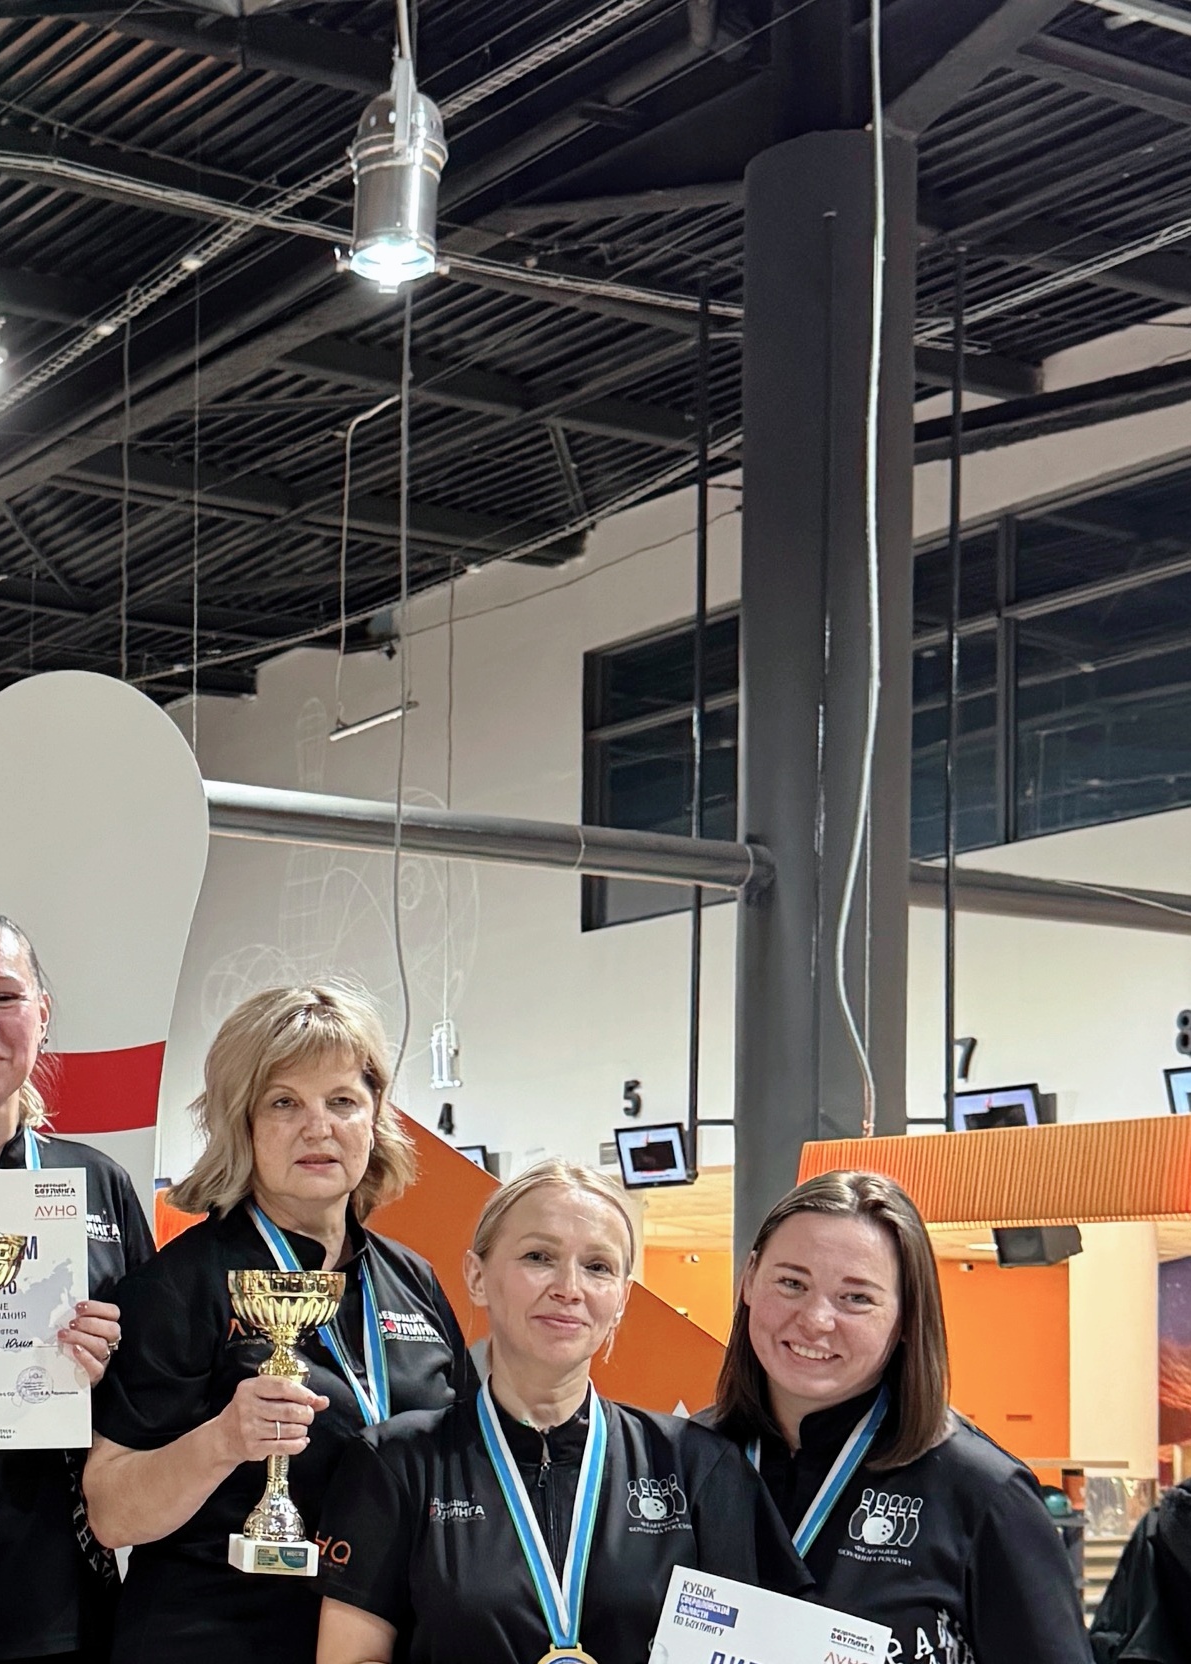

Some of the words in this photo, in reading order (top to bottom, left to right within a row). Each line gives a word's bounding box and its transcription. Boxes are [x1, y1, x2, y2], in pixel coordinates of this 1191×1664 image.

[953, 1036, 977, 1080] 7
[623, 1080, 642, 1117] 5
[437, 1103, 455, 1135] 4
[681, 1580, 717, 1599] КУБОК
[673, 1615, 684, 1626] ПО
